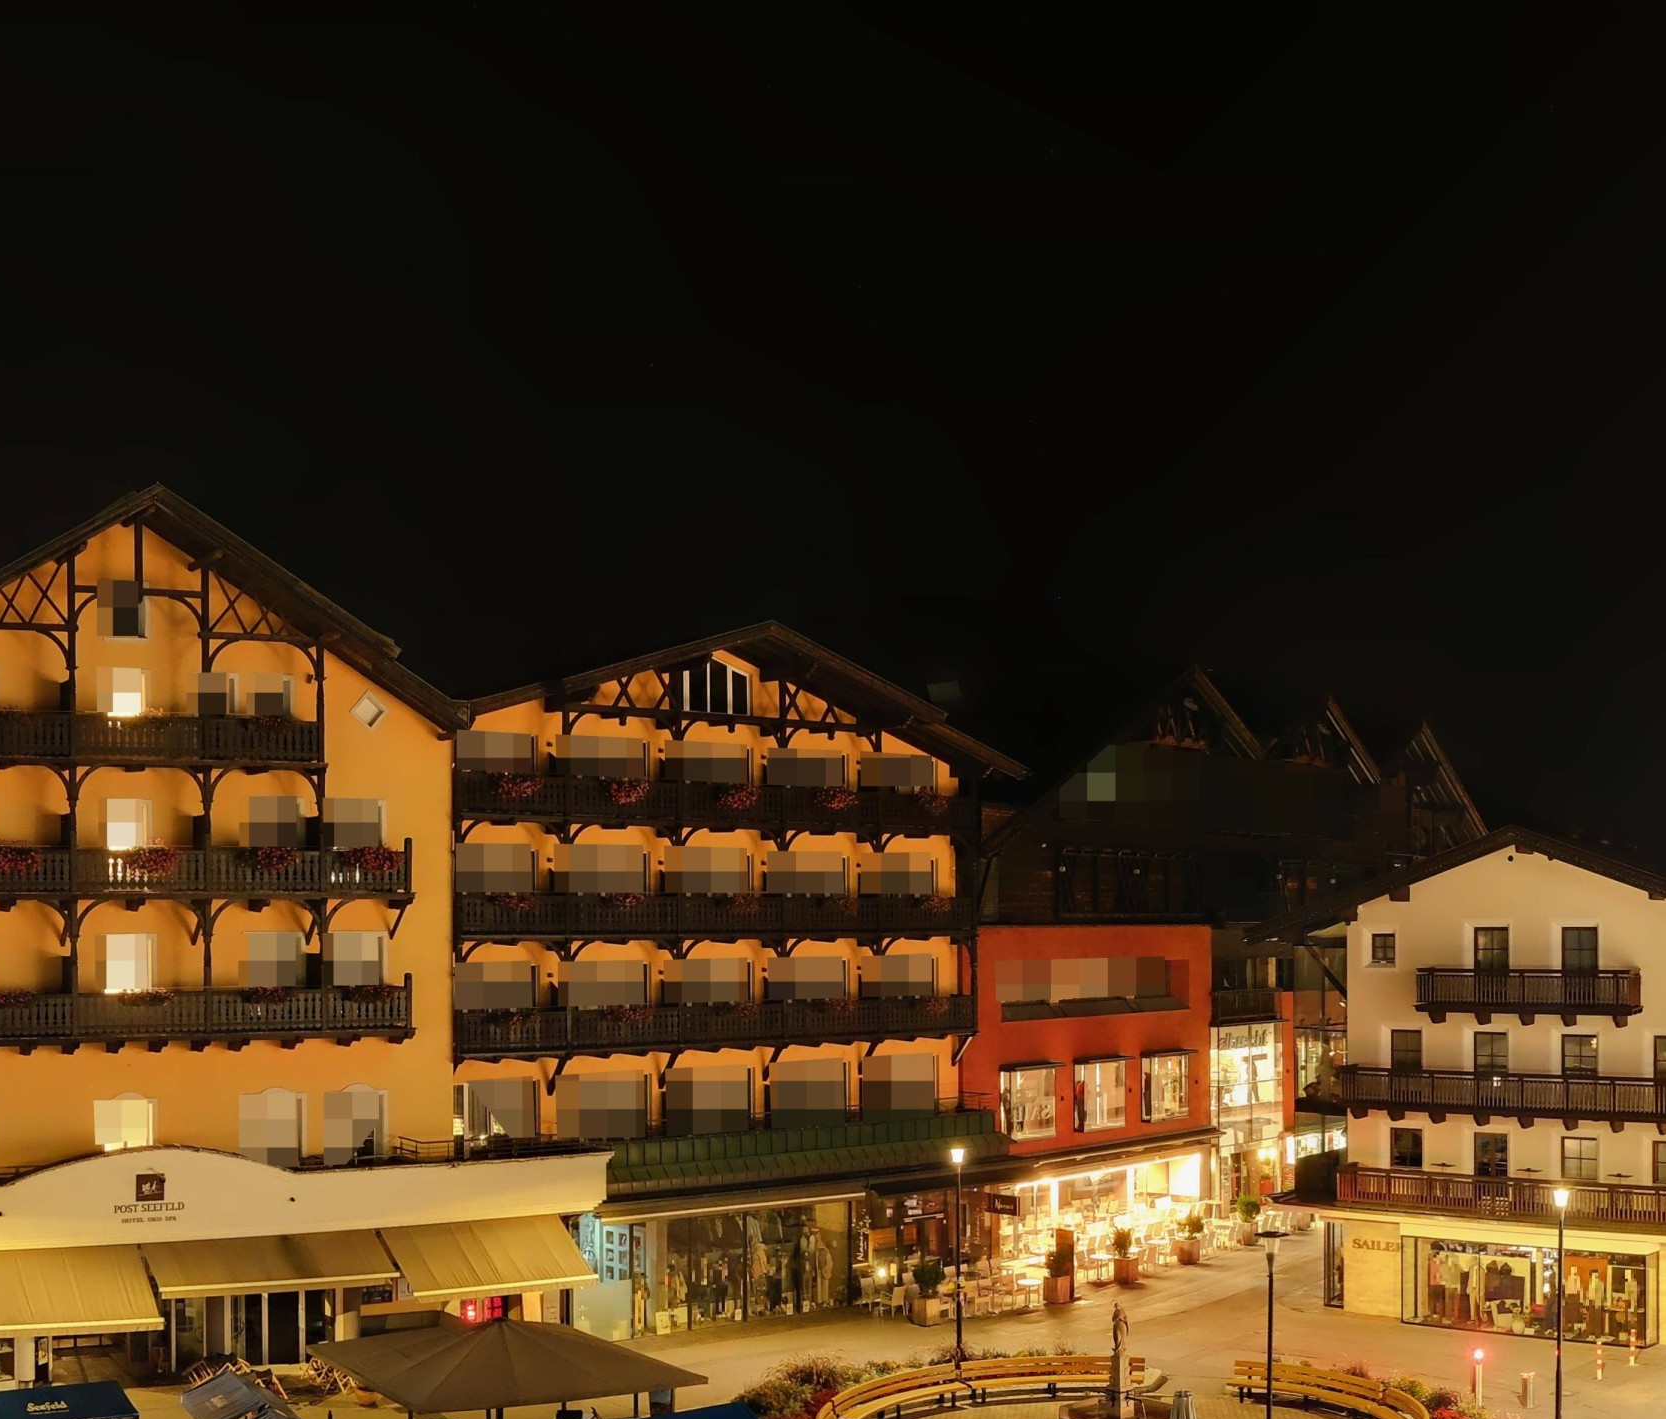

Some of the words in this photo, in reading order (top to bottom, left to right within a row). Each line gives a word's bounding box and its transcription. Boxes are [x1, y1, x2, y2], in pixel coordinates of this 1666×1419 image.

[114, 1204, 139, 1214] POST
[141, 1201, 185, 1213] SEEFELD
[26, 1400, 68, 1412] Seefeld
